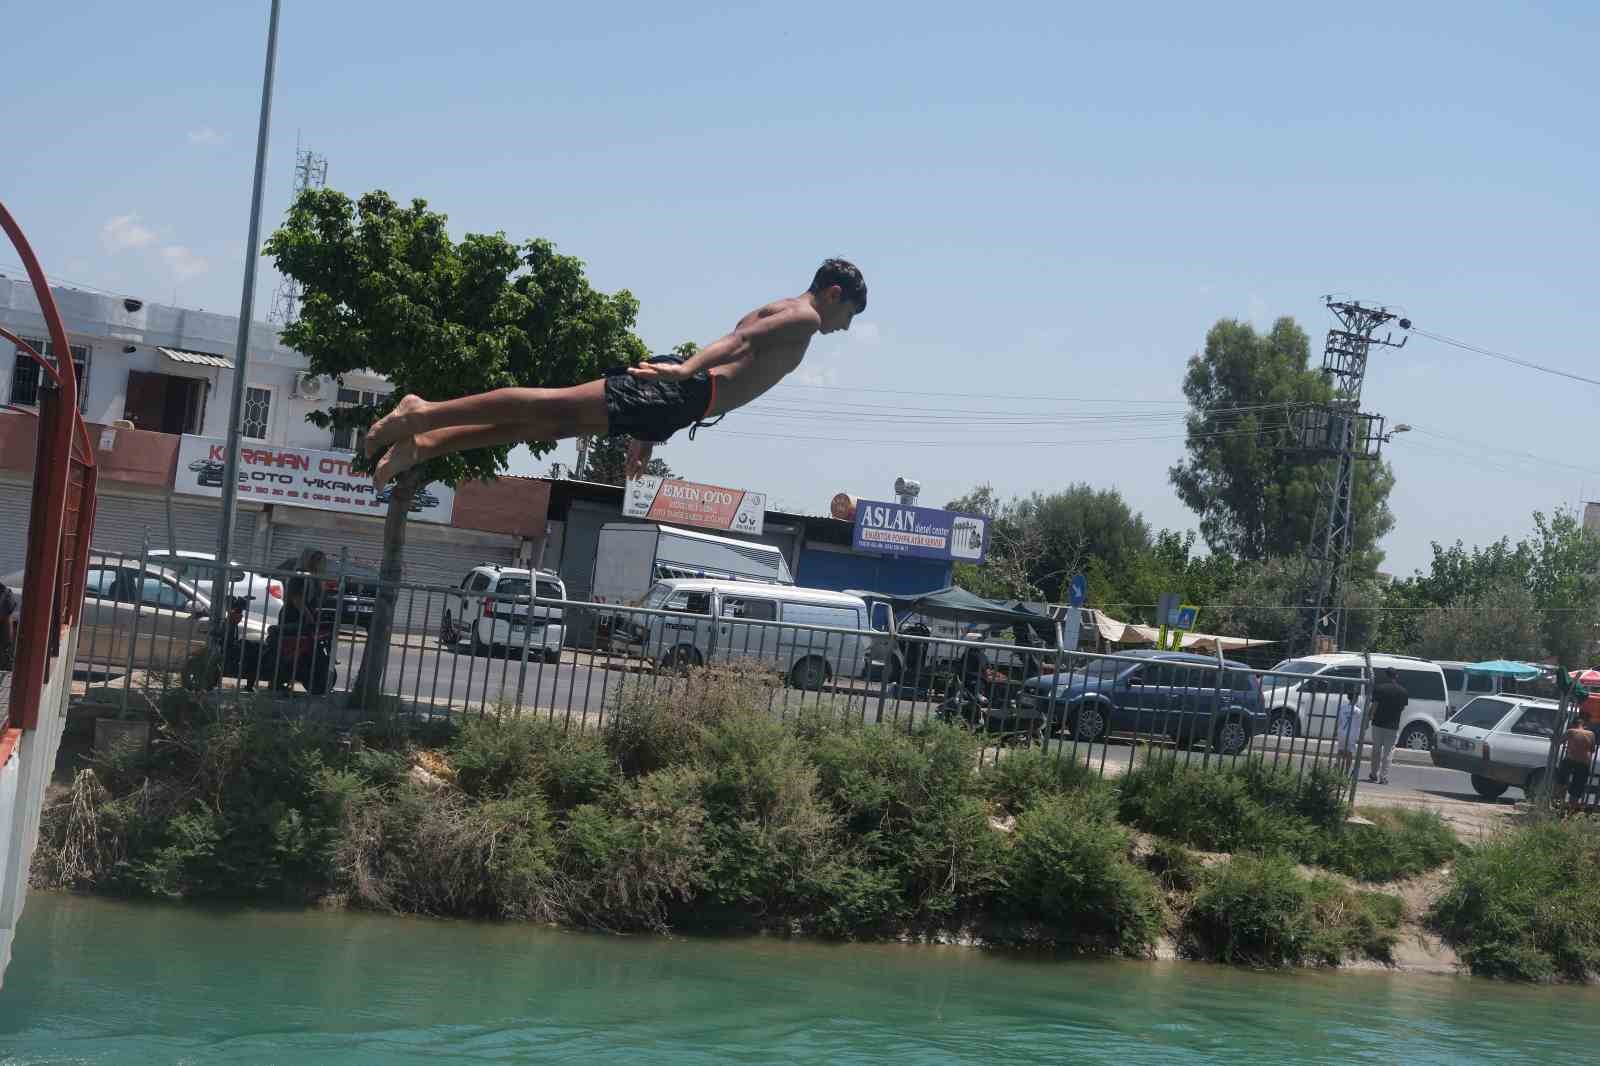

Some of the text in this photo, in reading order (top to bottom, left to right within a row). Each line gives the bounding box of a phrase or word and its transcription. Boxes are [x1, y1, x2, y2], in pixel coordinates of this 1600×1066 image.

[208, 445, 310, 472] KRAHAN
[251, 471, 375, 495] OTO YIKAMA
[703, 490, 733, 505] OTO
[861, 505, 915, 532] ASLAN
